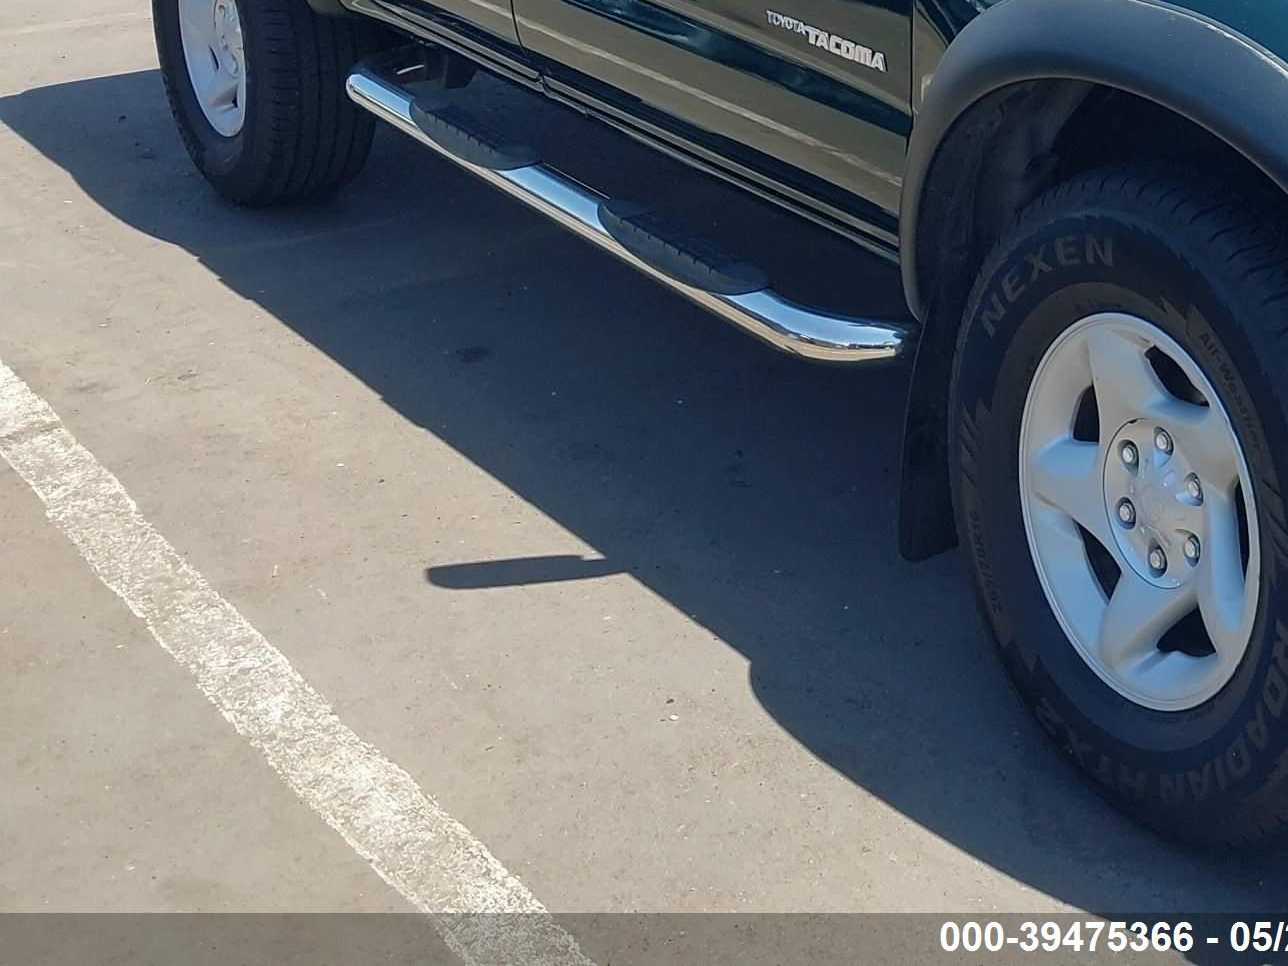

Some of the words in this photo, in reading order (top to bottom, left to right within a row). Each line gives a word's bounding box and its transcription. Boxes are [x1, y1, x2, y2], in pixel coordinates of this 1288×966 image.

[766, 10, 807, 37] TOYOTA
[805, 25, 887, 73] TACOMA
[981, 233, 1114, 338] NEXEN
